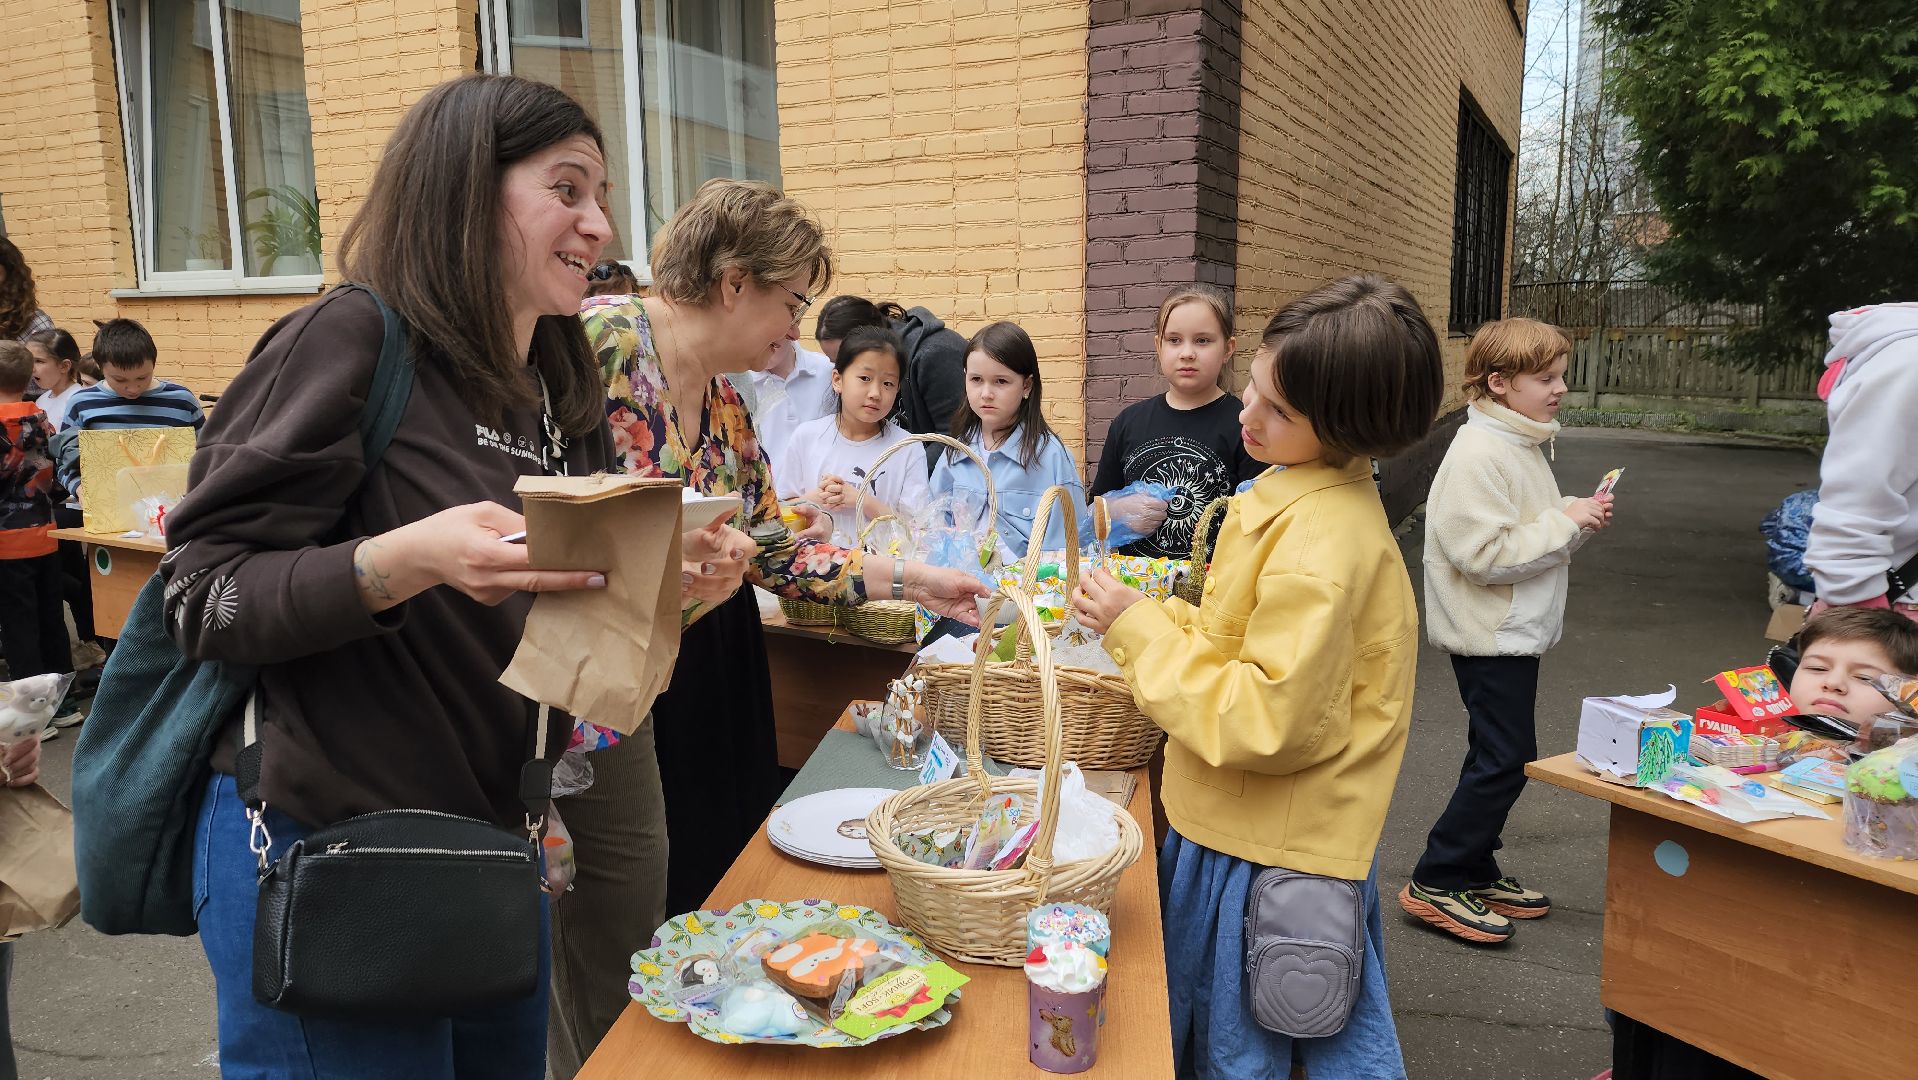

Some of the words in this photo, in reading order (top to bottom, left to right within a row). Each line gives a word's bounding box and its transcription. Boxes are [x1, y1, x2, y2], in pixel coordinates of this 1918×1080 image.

[475, 424, 500, 442] FILA
[477, 437, 489, 446] BE
[1699, 718, 1741, 735] ГУАШЬ
